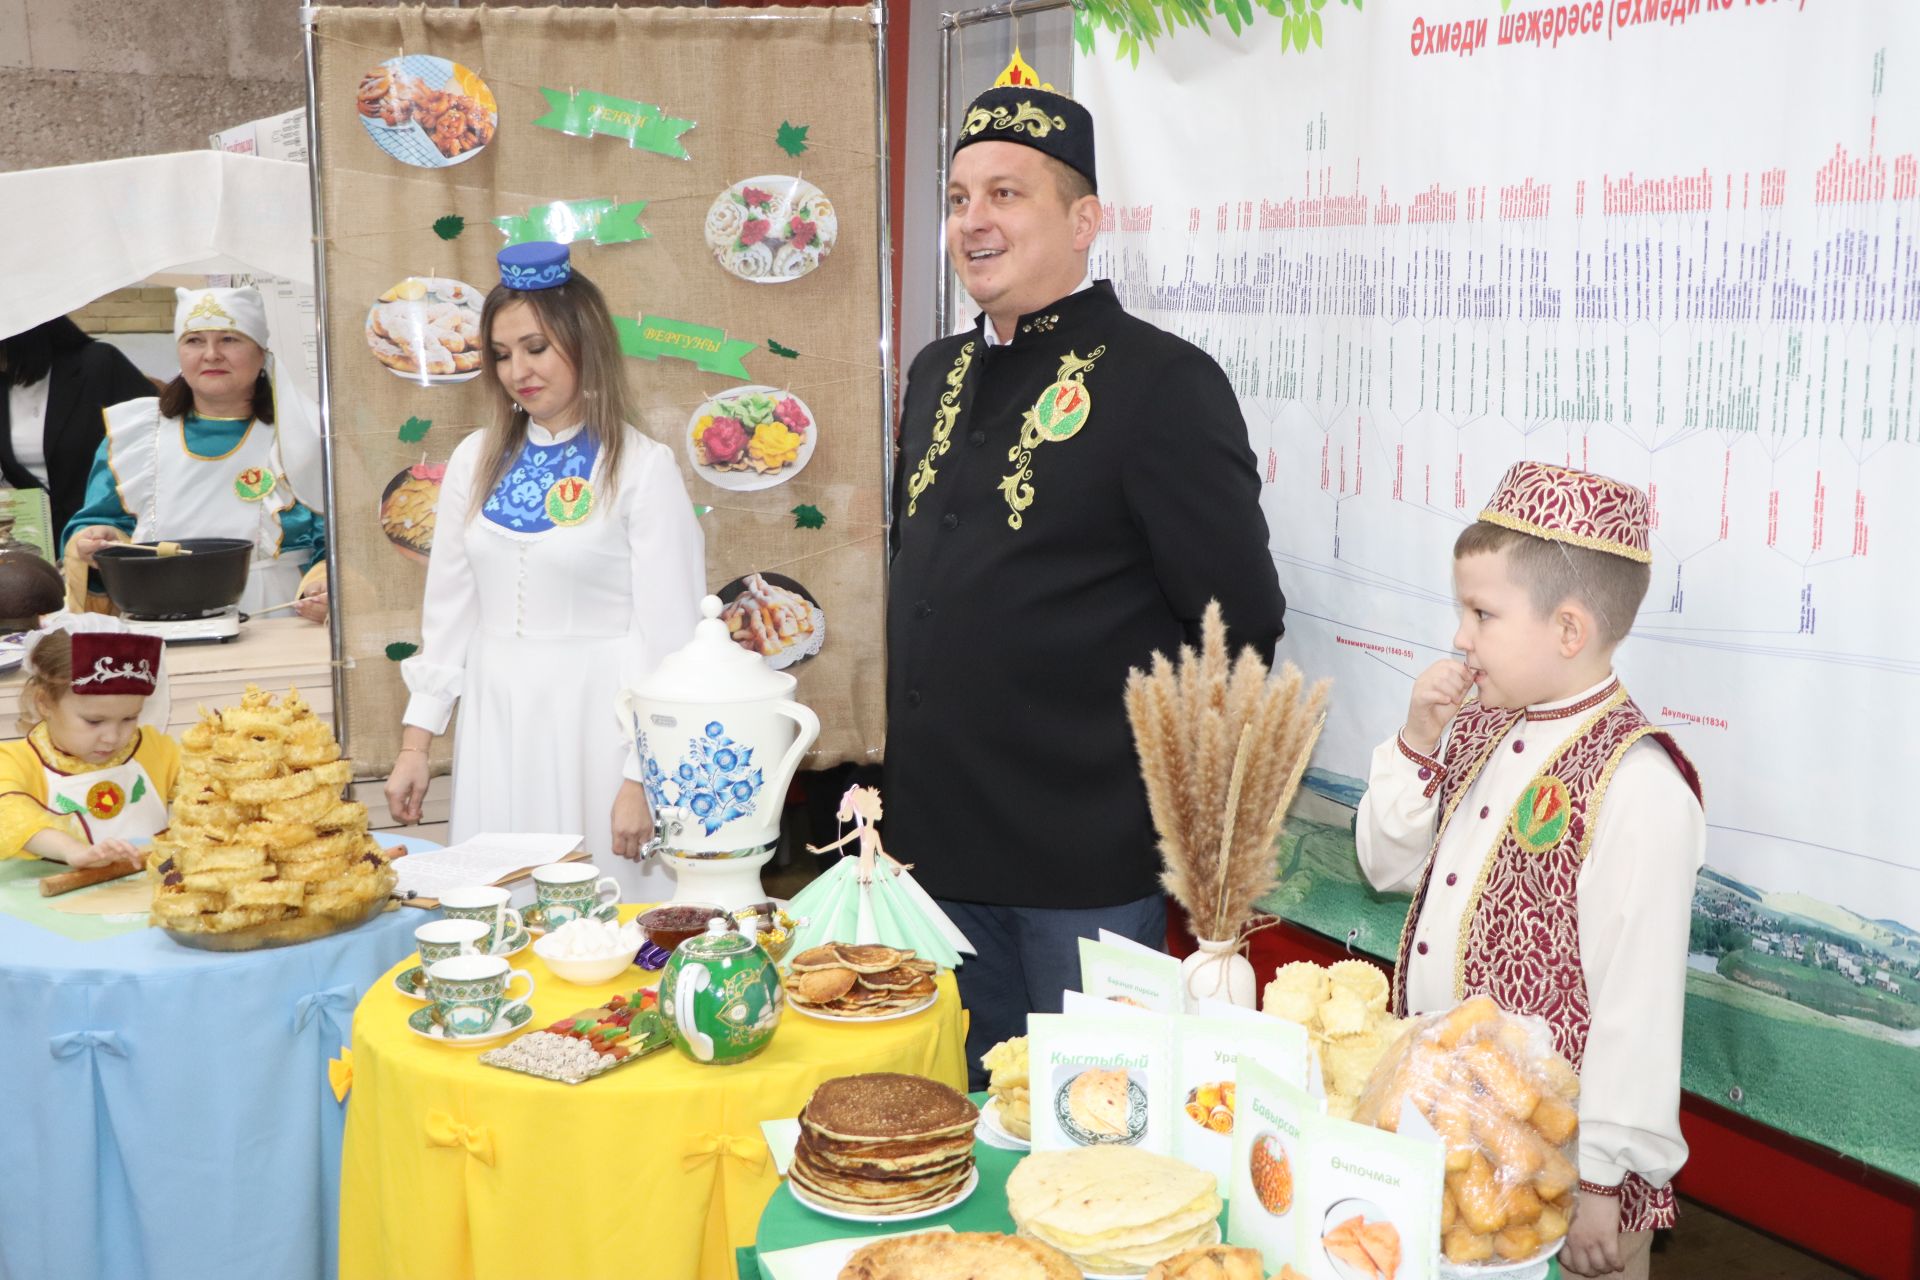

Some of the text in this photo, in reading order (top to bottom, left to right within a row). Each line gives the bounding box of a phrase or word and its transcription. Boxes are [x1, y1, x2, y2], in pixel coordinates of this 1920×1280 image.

[1411, 17, 1488, 57] Әхмәди
[1497, 1, 1603, 48] шәҗәрәсе
[643, 327, 722, 353] ВЕРГУНЫ
[1386, 647, 1414, 660] (1840-55)
[1702, 716, 1728, 730] (1834)
[1051, 1050, 1149, 1068] Кыстыбый
[1252, 1097, 1301, 1139] Бавырсак
[1331, 1156, 1401, 1188] Өчпочмак
